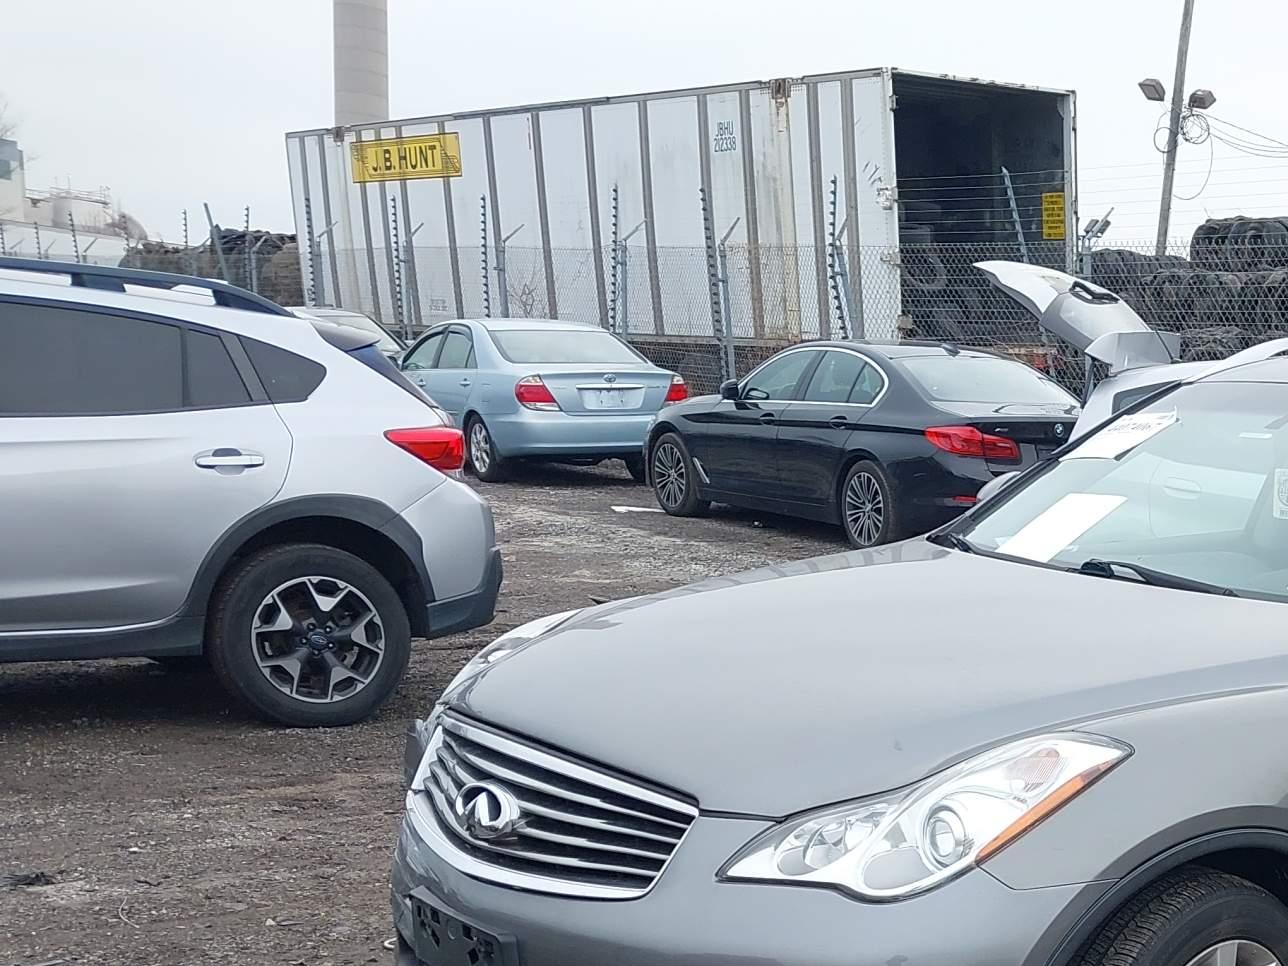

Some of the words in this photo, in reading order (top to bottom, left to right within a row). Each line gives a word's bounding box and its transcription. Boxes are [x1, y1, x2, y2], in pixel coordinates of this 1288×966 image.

[715, 120, 734, 137] JBHU
[372, 148, 396, 172] J.B.
[397, 144, 437, 170] HUNT
